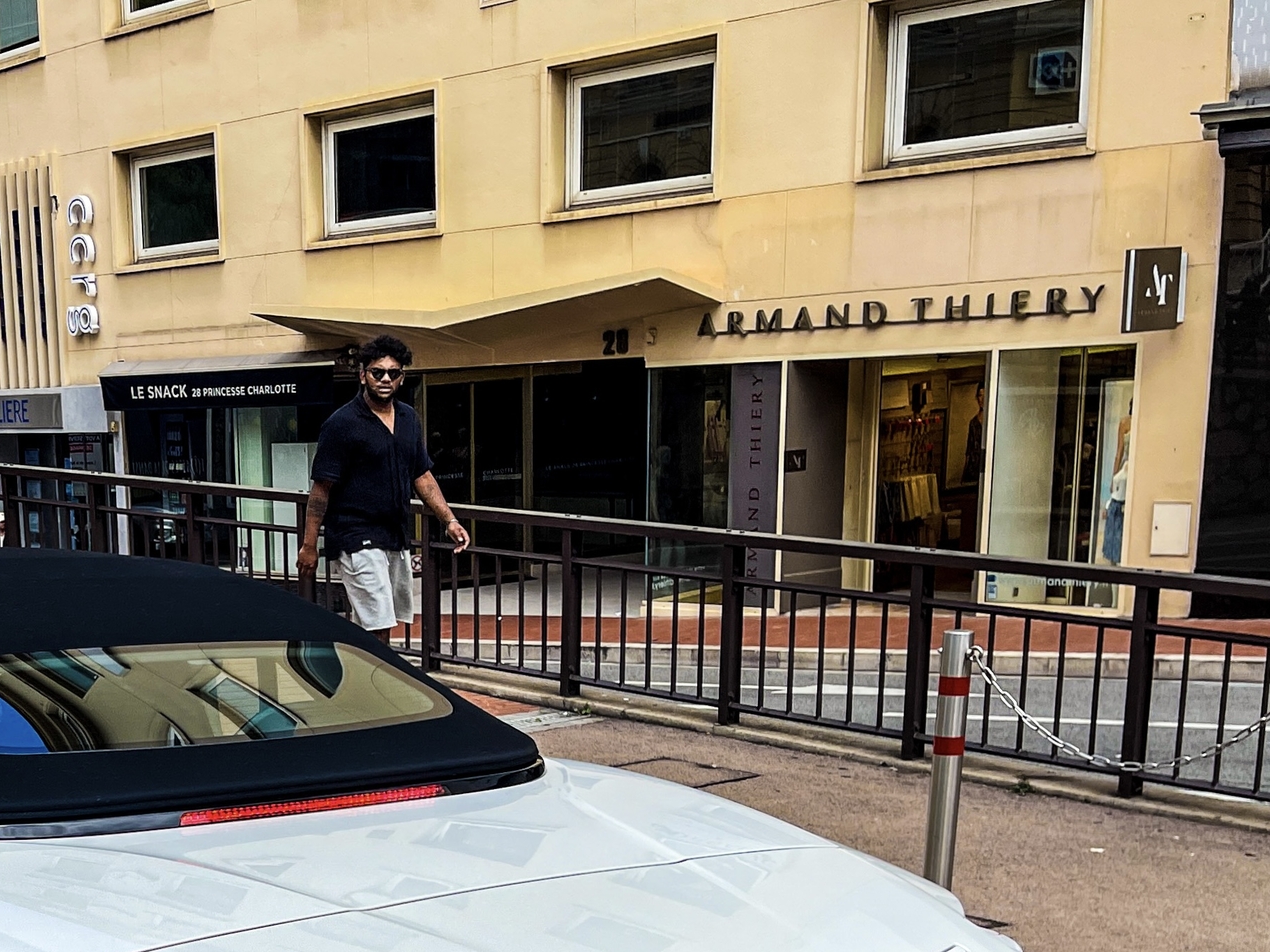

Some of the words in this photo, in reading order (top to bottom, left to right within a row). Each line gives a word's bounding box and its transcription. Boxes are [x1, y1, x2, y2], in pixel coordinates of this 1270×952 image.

[697, 301, 887, 337] ARMAND
[910, 284, 1105, 322] THIERY
[130, 386, 145, 399] LE
[147, 384, 188, 399] SNACK
[191, 388, 202, 397] 28
[203, 386, 246, 397] PRINCESSE
[247, 383, 297, 395] CHARLOTTE
[750, 374, 764, 468] THIERY
